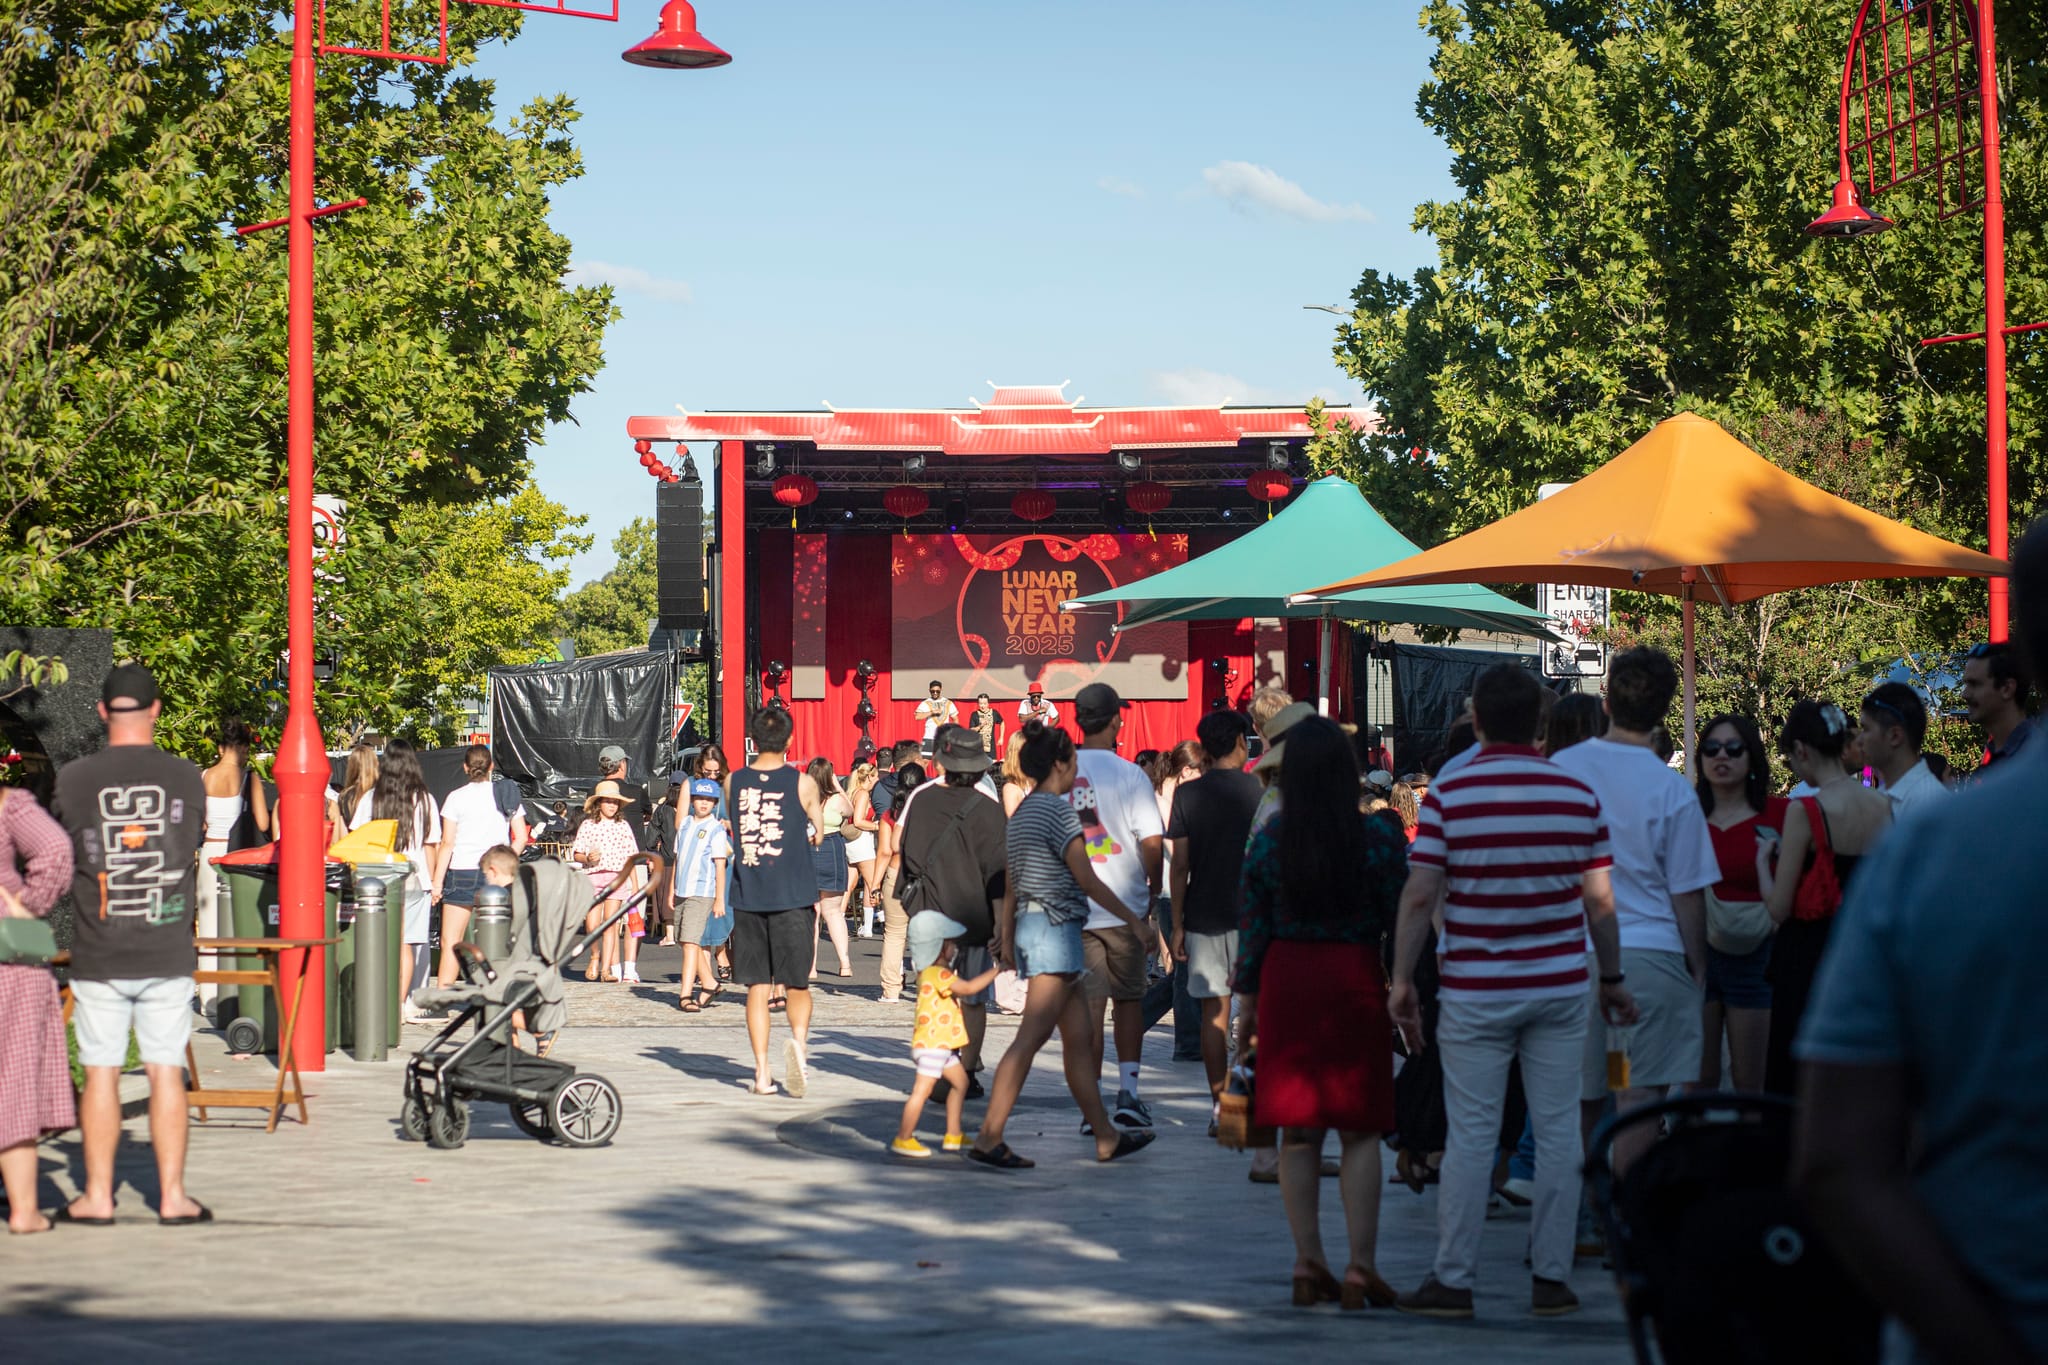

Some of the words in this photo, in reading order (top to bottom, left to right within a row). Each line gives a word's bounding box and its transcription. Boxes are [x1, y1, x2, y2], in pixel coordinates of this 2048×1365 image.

[1002, 571, 1077, 589] LUNAR
[1002, 588, 1078, 614] NEW
[1554, 583, 1597, 601] END
[1002, 614, 1076, 635] YEAR
[1553, 609, 1598, 620] SHARED
[1005, 635, 1075, 655] 2025
[98, 785, 166, 922] SLNT
